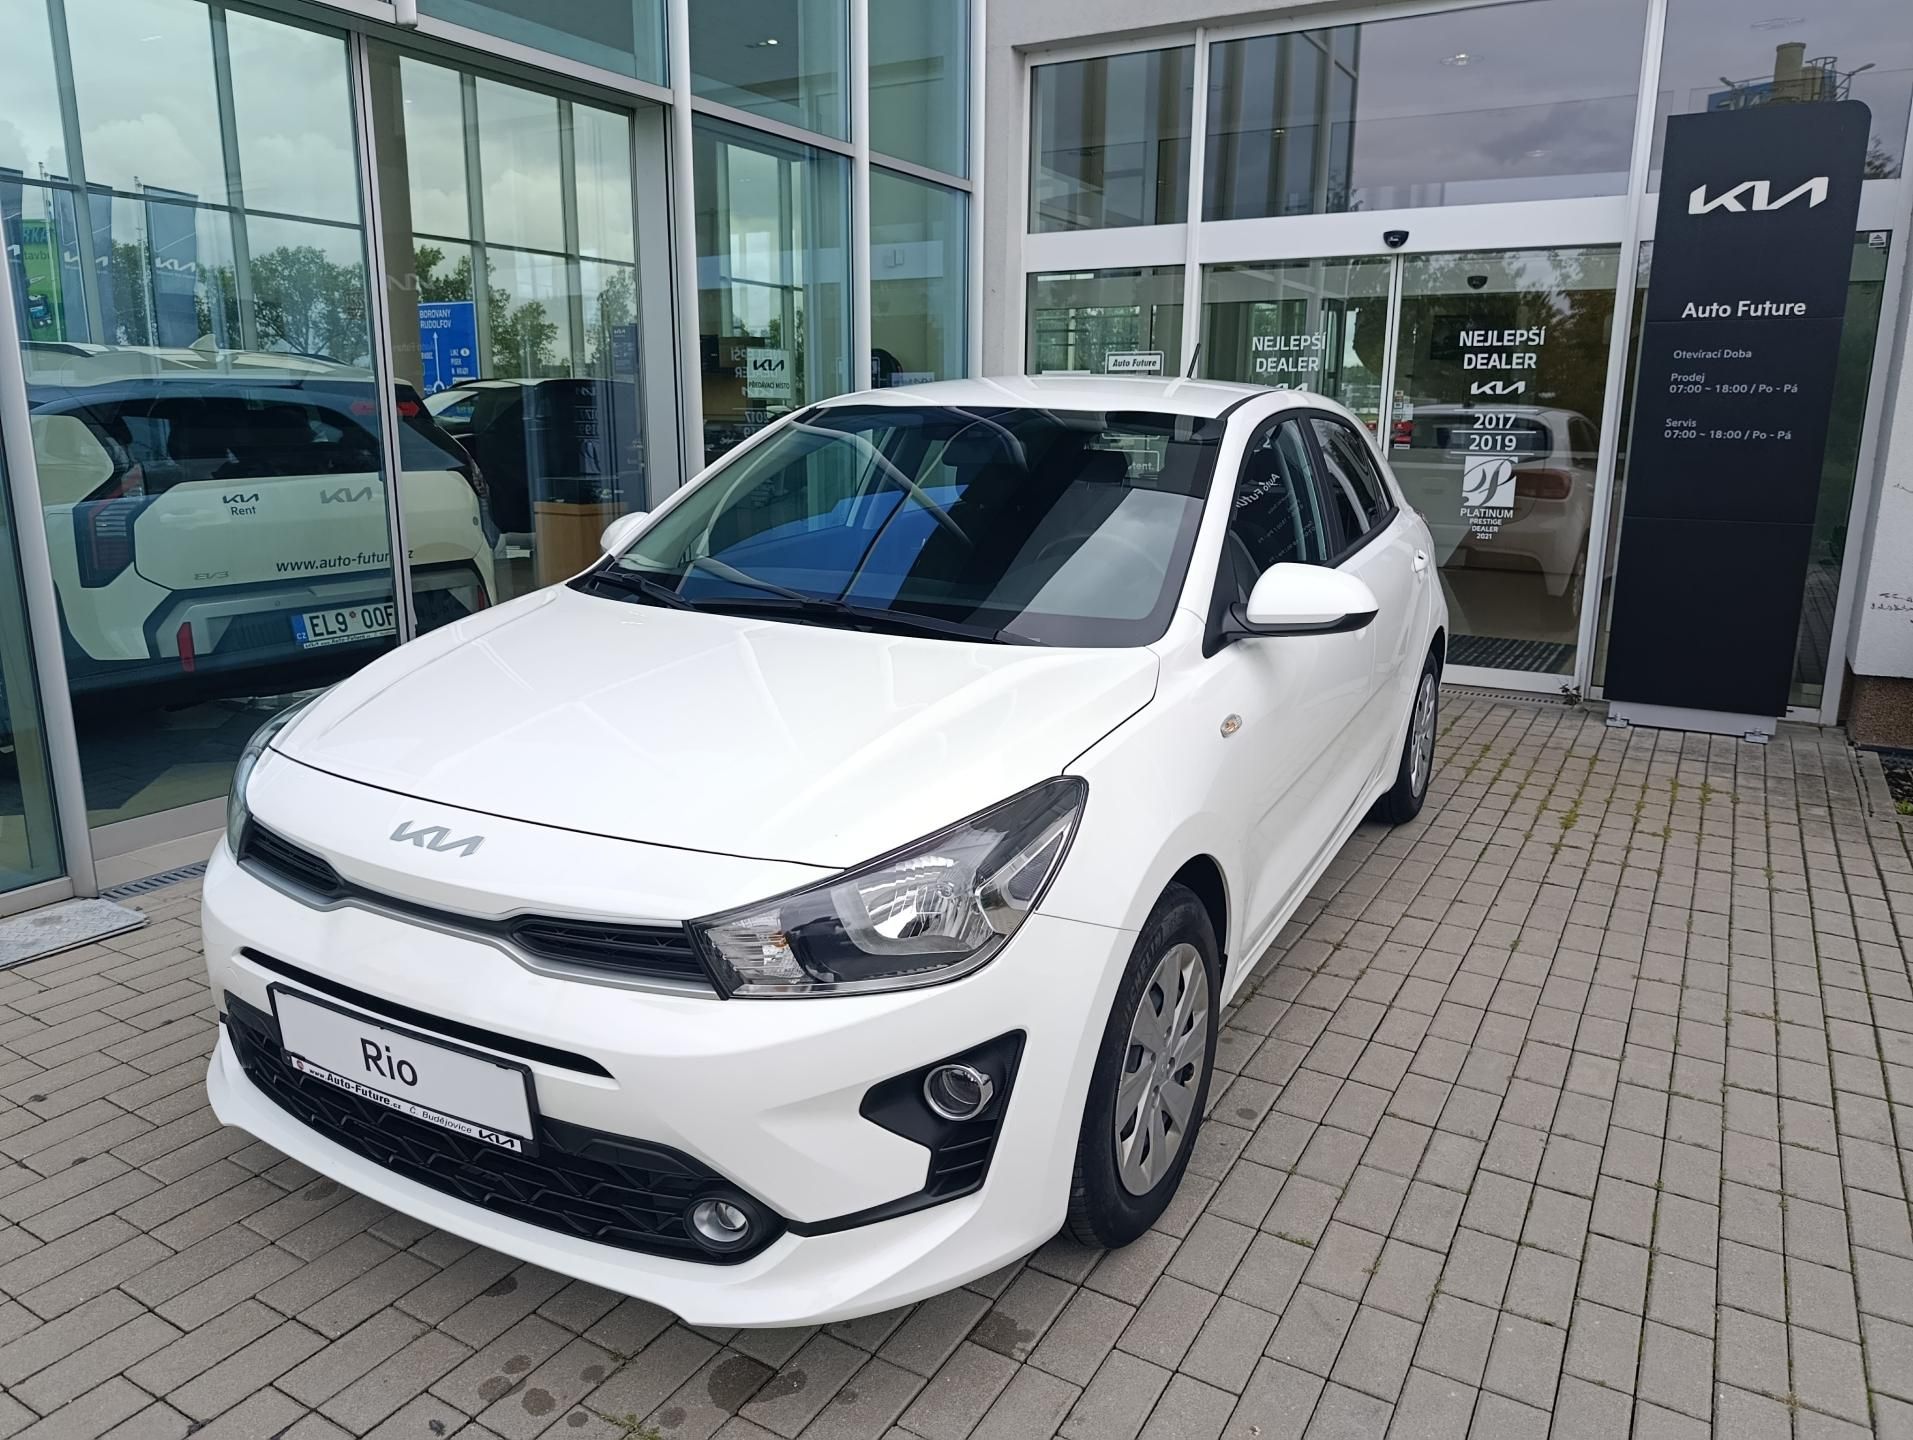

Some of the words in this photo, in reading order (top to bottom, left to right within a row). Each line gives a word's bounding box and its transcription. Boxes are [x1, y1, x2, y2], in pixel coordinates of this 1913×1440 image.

[1688, 176, 1829, 214] KIA
[420, 309, 451, 319] BOROVANY
[1682, 302, 1731, 318] Auto
[1737, 300, 1806, 317] Future
[420, 320, 452, 329] RUDOLFOV
[1252, 332, 1327, 351] NEJLEPŠÍ
[1459, 326, 1546, 347] NEJLEPŠÍ
[1463, 353, 1537, 369] DEALER
[1673, 350, 1721, 359] Otevírací
[1724, 350, 1752, 359] Doba
[753, 359, 785, 371] KIA
[1112, 359, 1130, 367] Auto
[1132, 359, 1157, 367] Future
[1256, 357, 1320, 373] DEALER
[1671, 373, 1705, 383] Prodej
[1470, 381, 1526, 395] KIA
[1669, 384, 1702, 393] 07:00
[1715, 384, 1748, 393] 18:00
[1758, 385, 1773, 393] Po
[1783, 384, 1798, 393] Pá
[1473, 413, 1516, 429] 2017
[1665, 418, 1697, 427] Servis
[1664, 430, 1697, 438] 07:00
[1710, 430, 1742, 439] 18:00
[1752, 431, 1767, 439] Po
[1777, 430, 1792, 440] Pá
[1468, 435, 1517, 451] 2019
[222, 493, 259, 504] KIA
[320, 486, 372, 504] KIA
[230, 505, 256, 516] Rent
[1460, 508, 1514, 518] PLATINUM
[276, 550, 413, 572] www.auto-futurz
[309, 612, 348, 637] EL9
[296, 632, 307, 640] CZ
[389, 820, 485, 858] KIA
[360, 1037, 418, 1086] Rio
[309, 1067, 402, 1109] www.Auto-Future.cz
[422, 1110, 472, 1134] Budějovice
[478, 1129, 515, 1149] KIA
